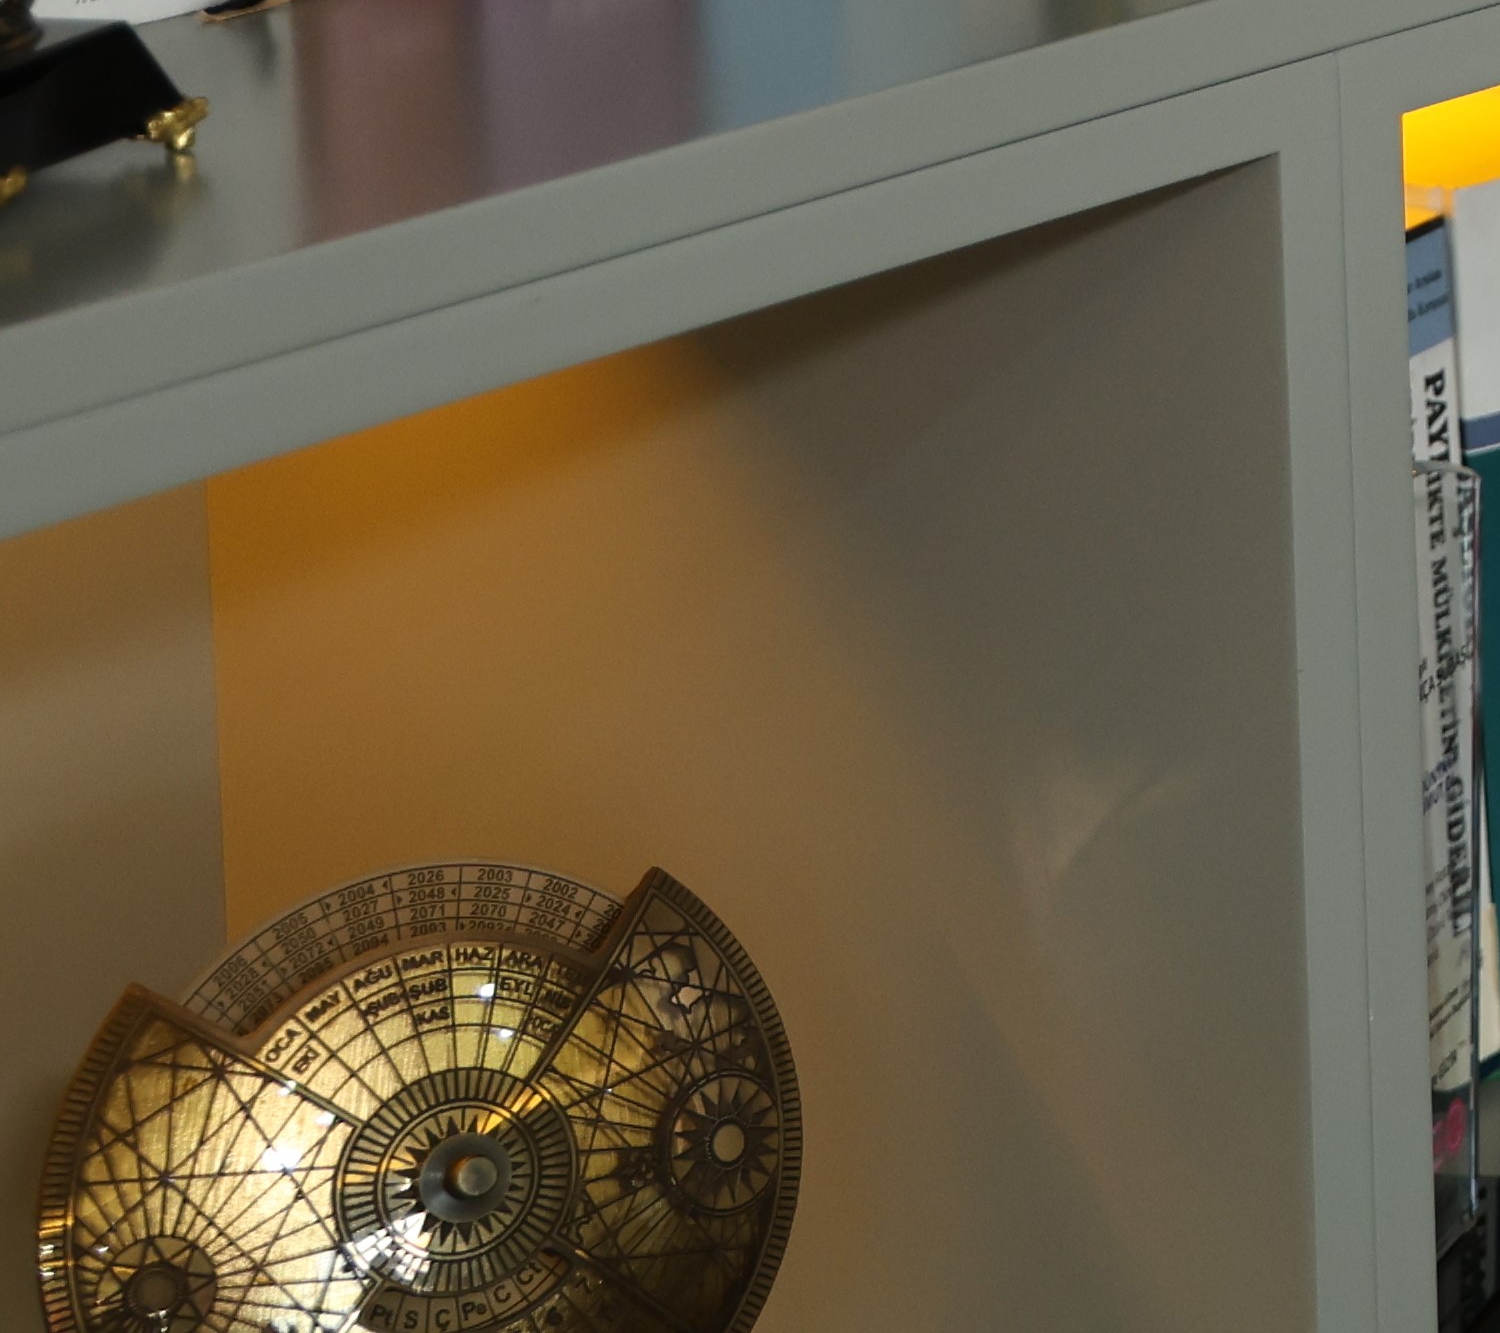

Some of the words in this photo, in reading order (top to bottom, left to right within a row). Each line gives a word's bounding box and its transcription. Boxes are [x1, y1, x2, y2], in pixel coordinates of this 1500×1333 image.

[408, 869, 445, 885] 2026
[478, 868, 514, 883] 2003
[474, 886, 511, 901] 2025
[536, 895, 571, 917] 2024
